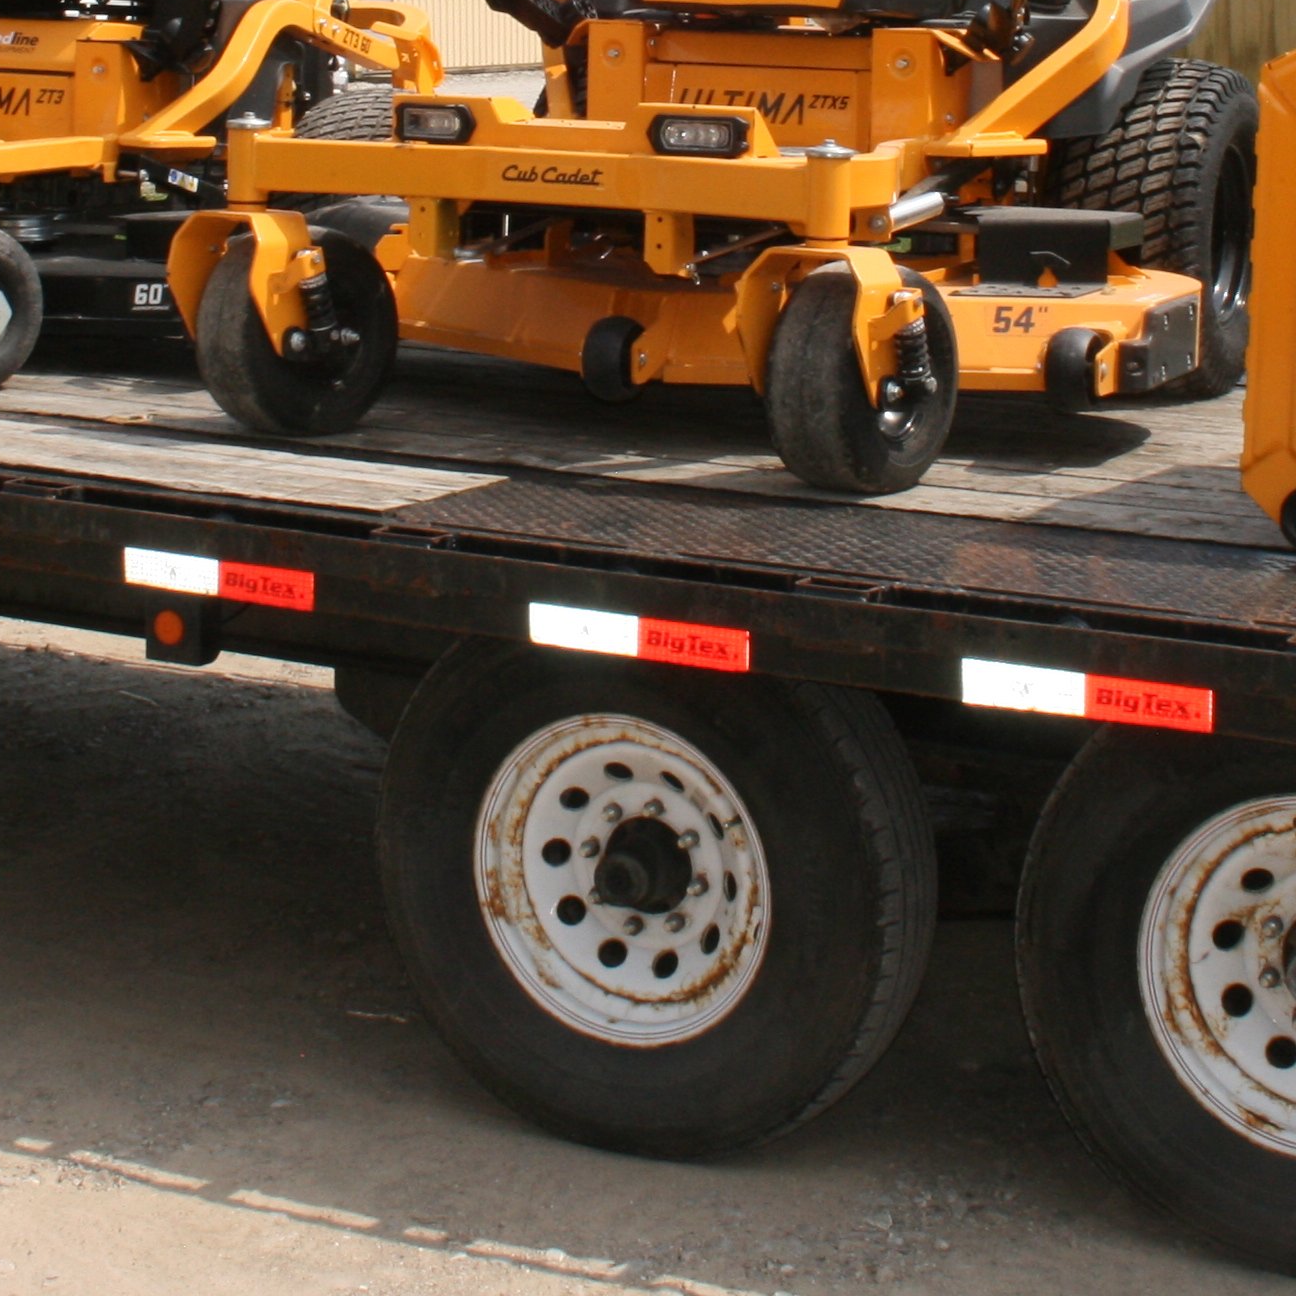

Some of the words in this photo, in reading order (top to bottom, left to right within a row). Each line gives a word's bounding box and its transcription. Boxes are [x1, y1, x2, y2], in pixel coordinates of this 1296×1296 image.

[35, 89, 65, 104] ZT3
[808, 94, 850, 110] ZTX5
[502, 165, 538, 182] Cub
[541, 166, 603, 186] Cadet
[992, 306, 1048, 334] 54"
[224, 572, 296, 595] BigTex
[647, 630, 729, 656] BigTex
[1096, 688, 1191, 715] BigTex
